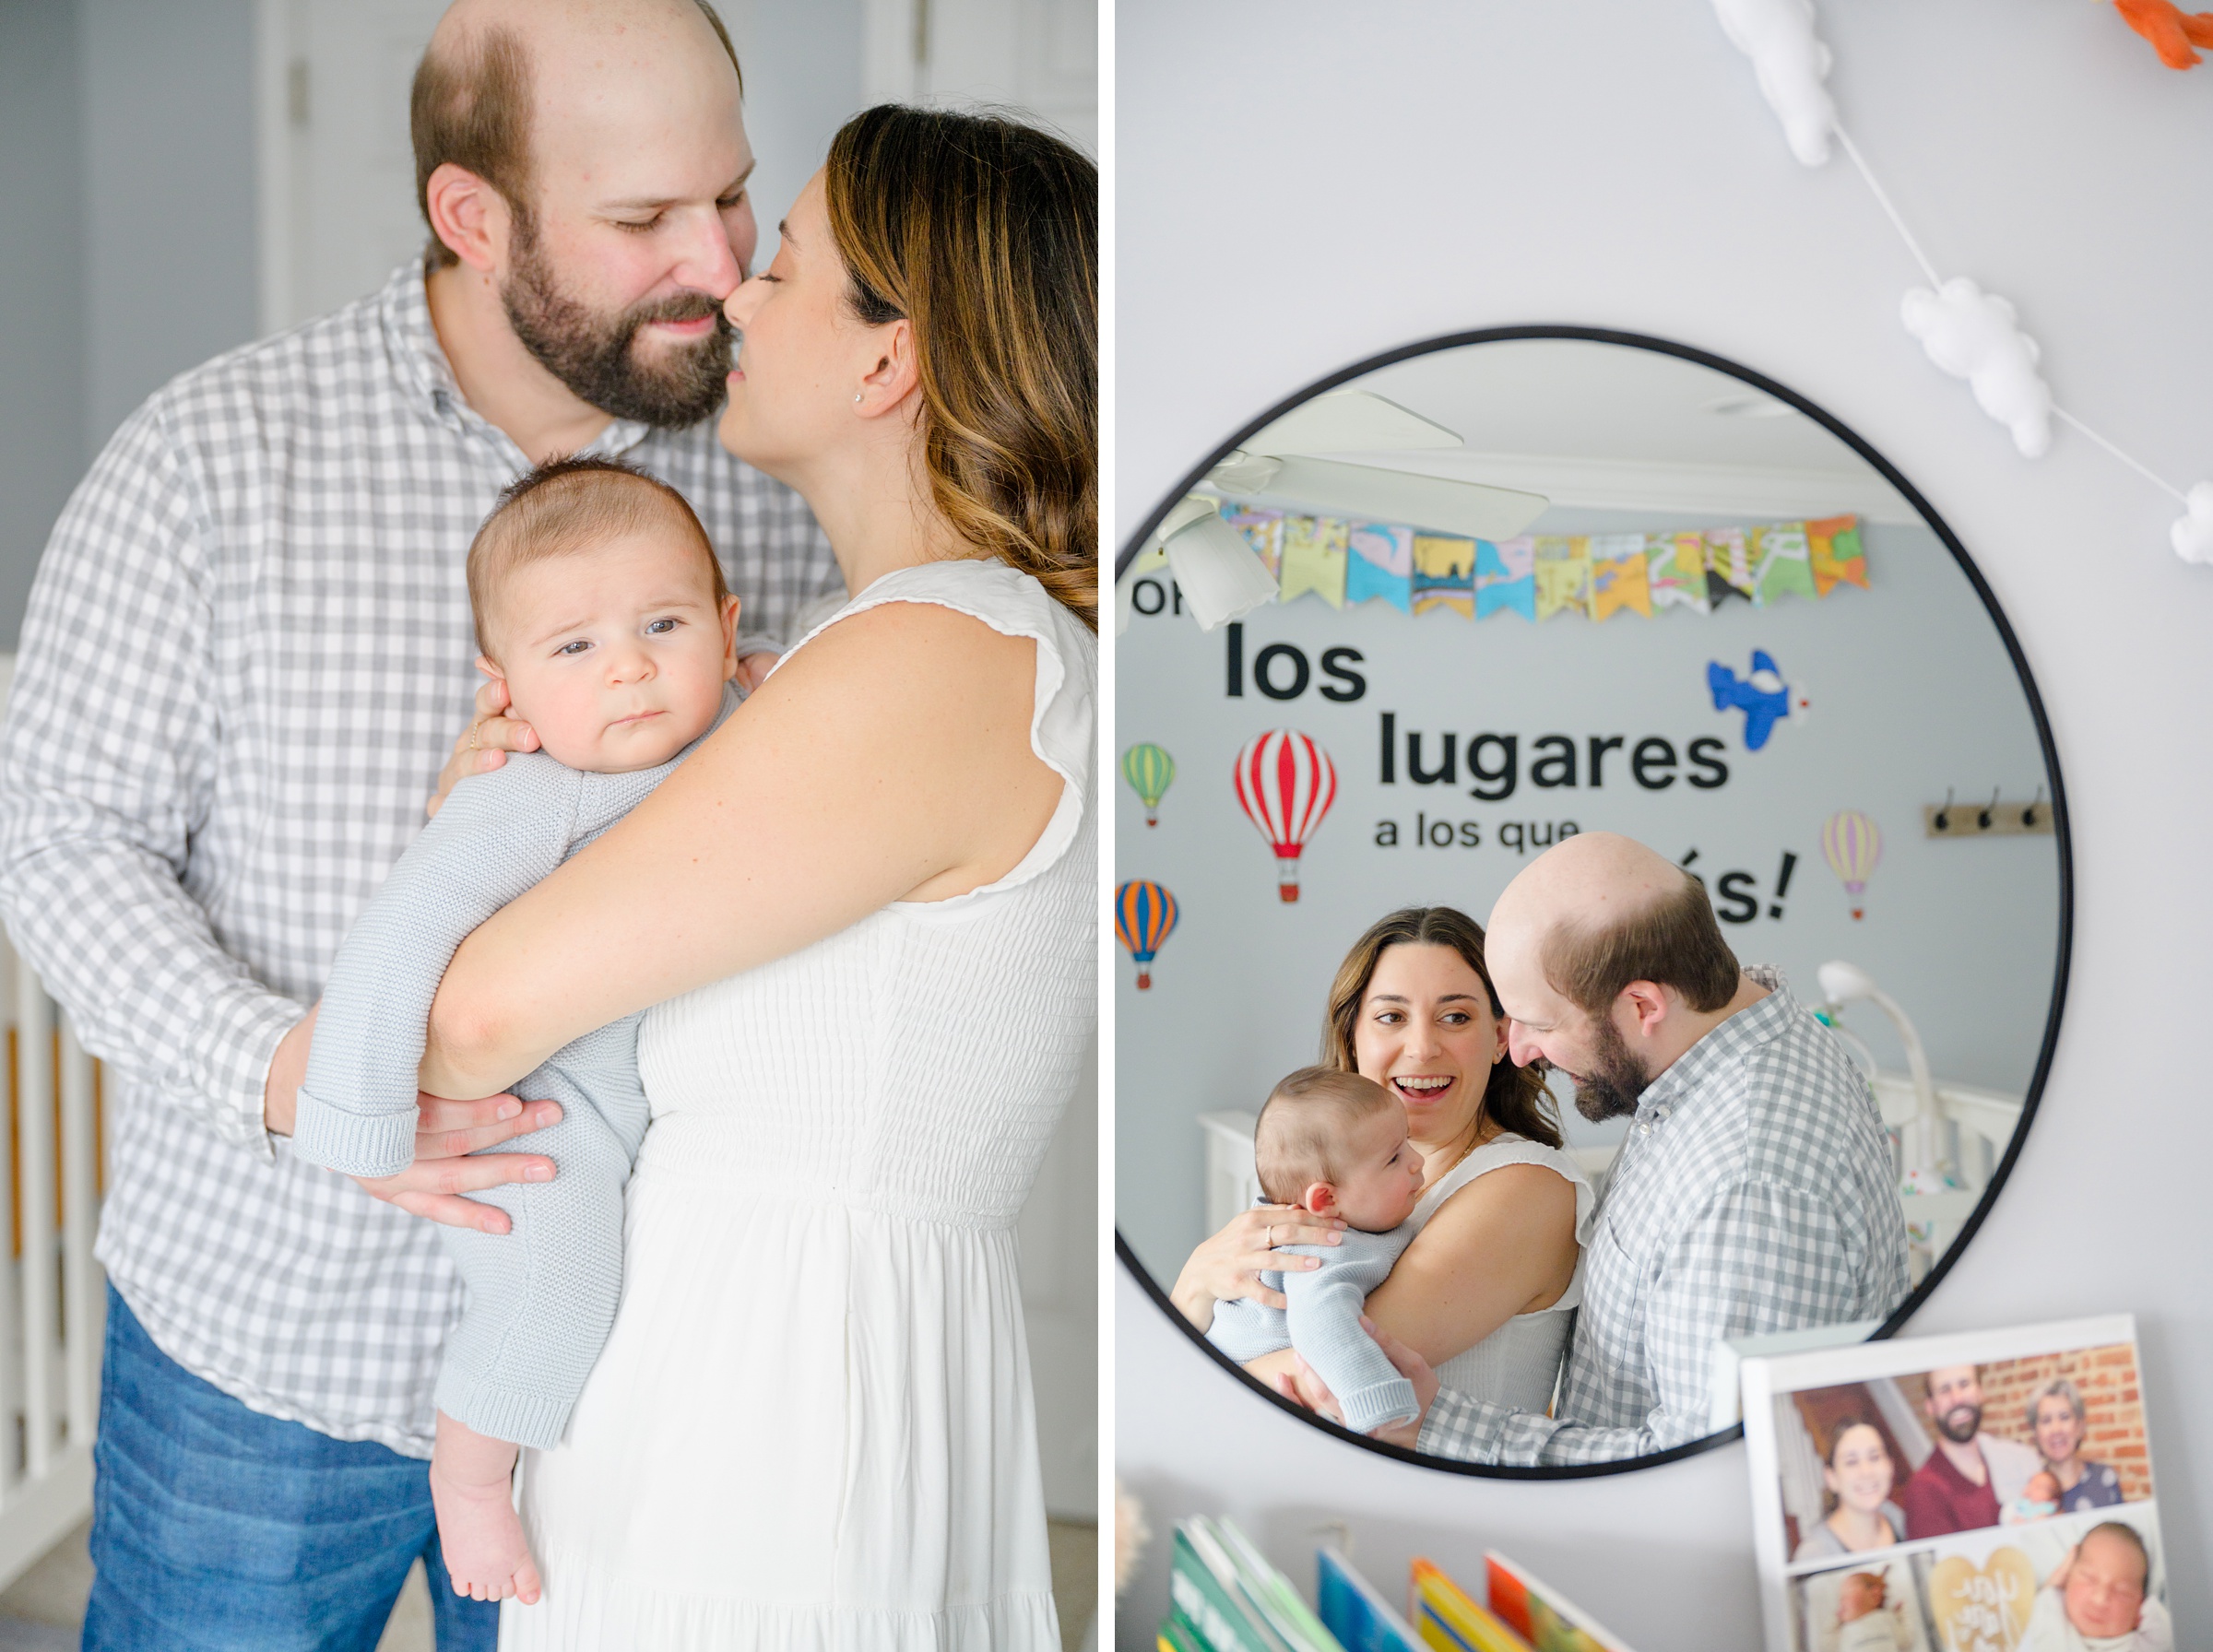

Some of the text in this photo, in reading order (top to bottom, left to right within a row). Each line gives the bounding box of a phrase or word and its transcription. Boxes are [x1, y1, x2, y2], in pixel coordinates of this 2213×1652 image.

[1225, 621, 1367, 703] los
[1379, 712, 1731, 802] lugares
[1374, 812, 1580, 856] a los que
[1682, 850, 1797, 923] s!
